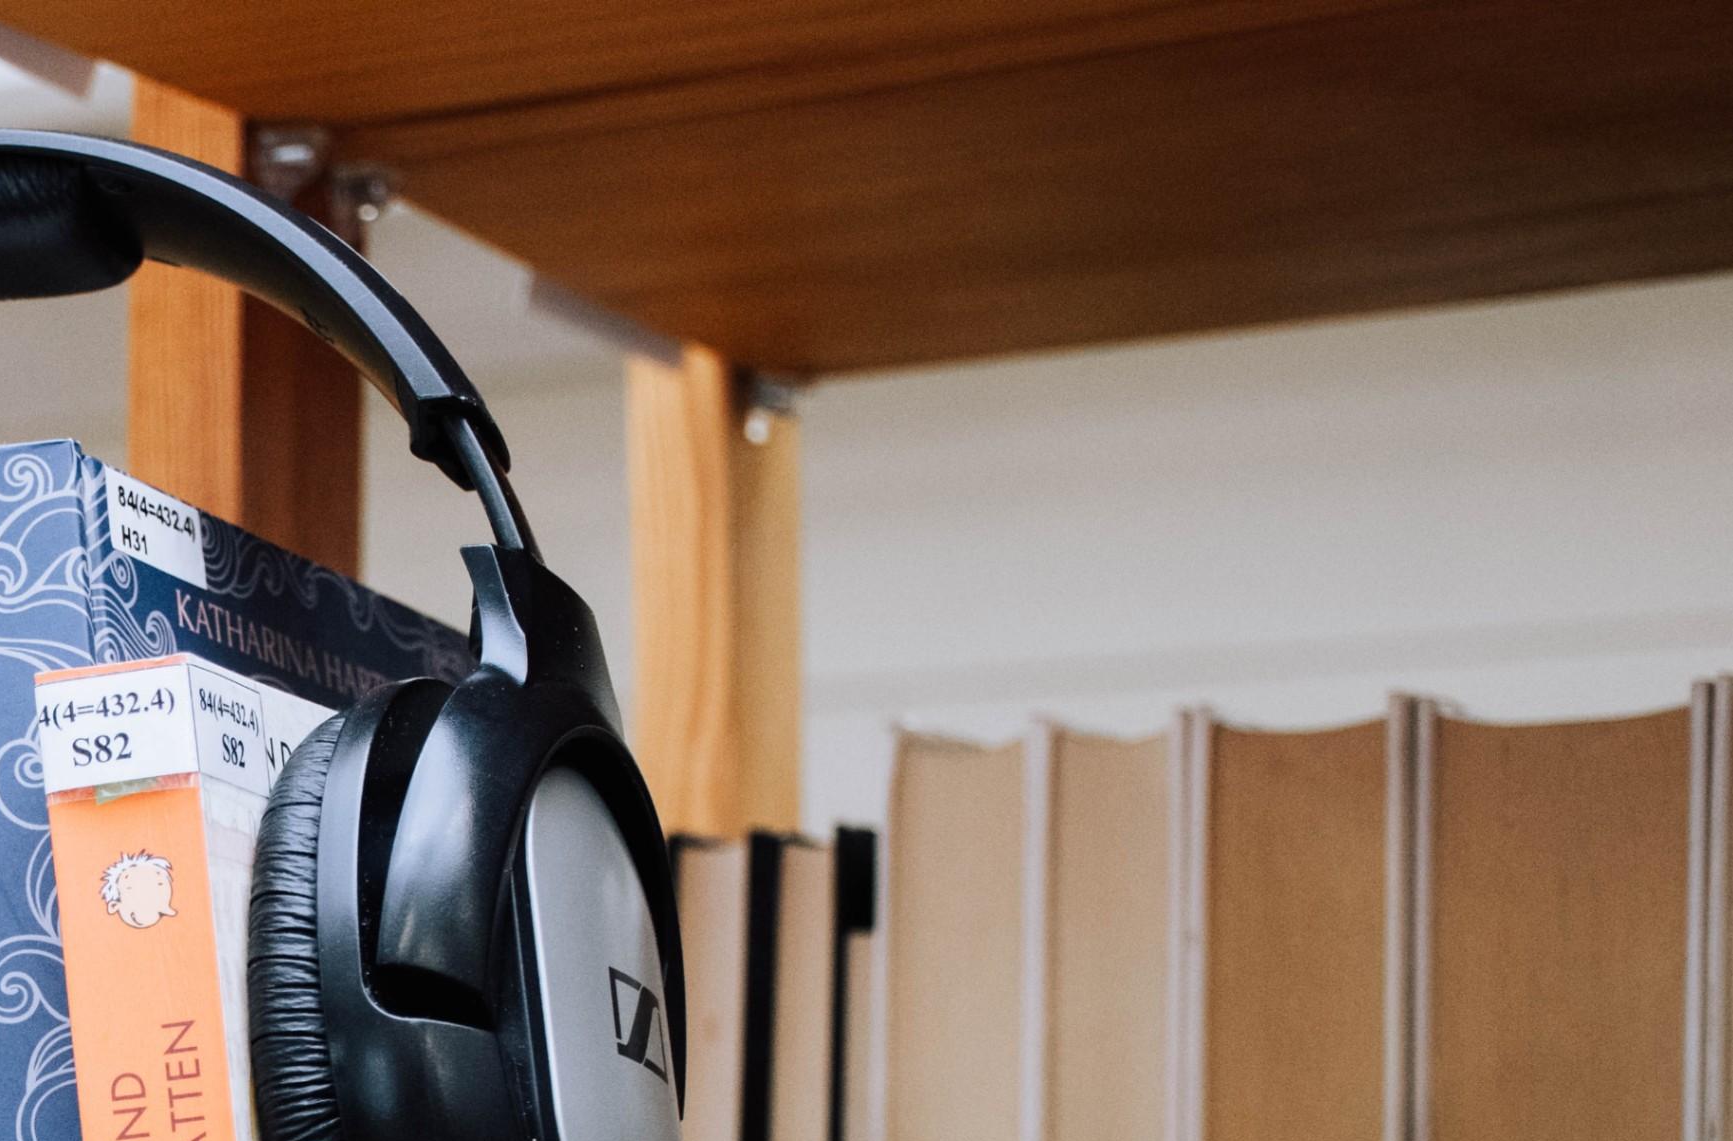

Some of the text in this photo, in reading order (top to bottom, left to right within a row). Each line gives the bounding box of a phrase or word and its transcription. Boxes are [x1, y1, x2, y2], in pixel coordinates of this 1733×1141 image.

[117, 484, 197, 543] 84(4=432.4)
[120, 523, 149, 556] H31
[174, 588, 318, 679] KATHARINA
[198, 687, 261, 736] 84(4=432.4)
[71, 732, 134, 767] S82
[221, 733, 246, 769] S82
